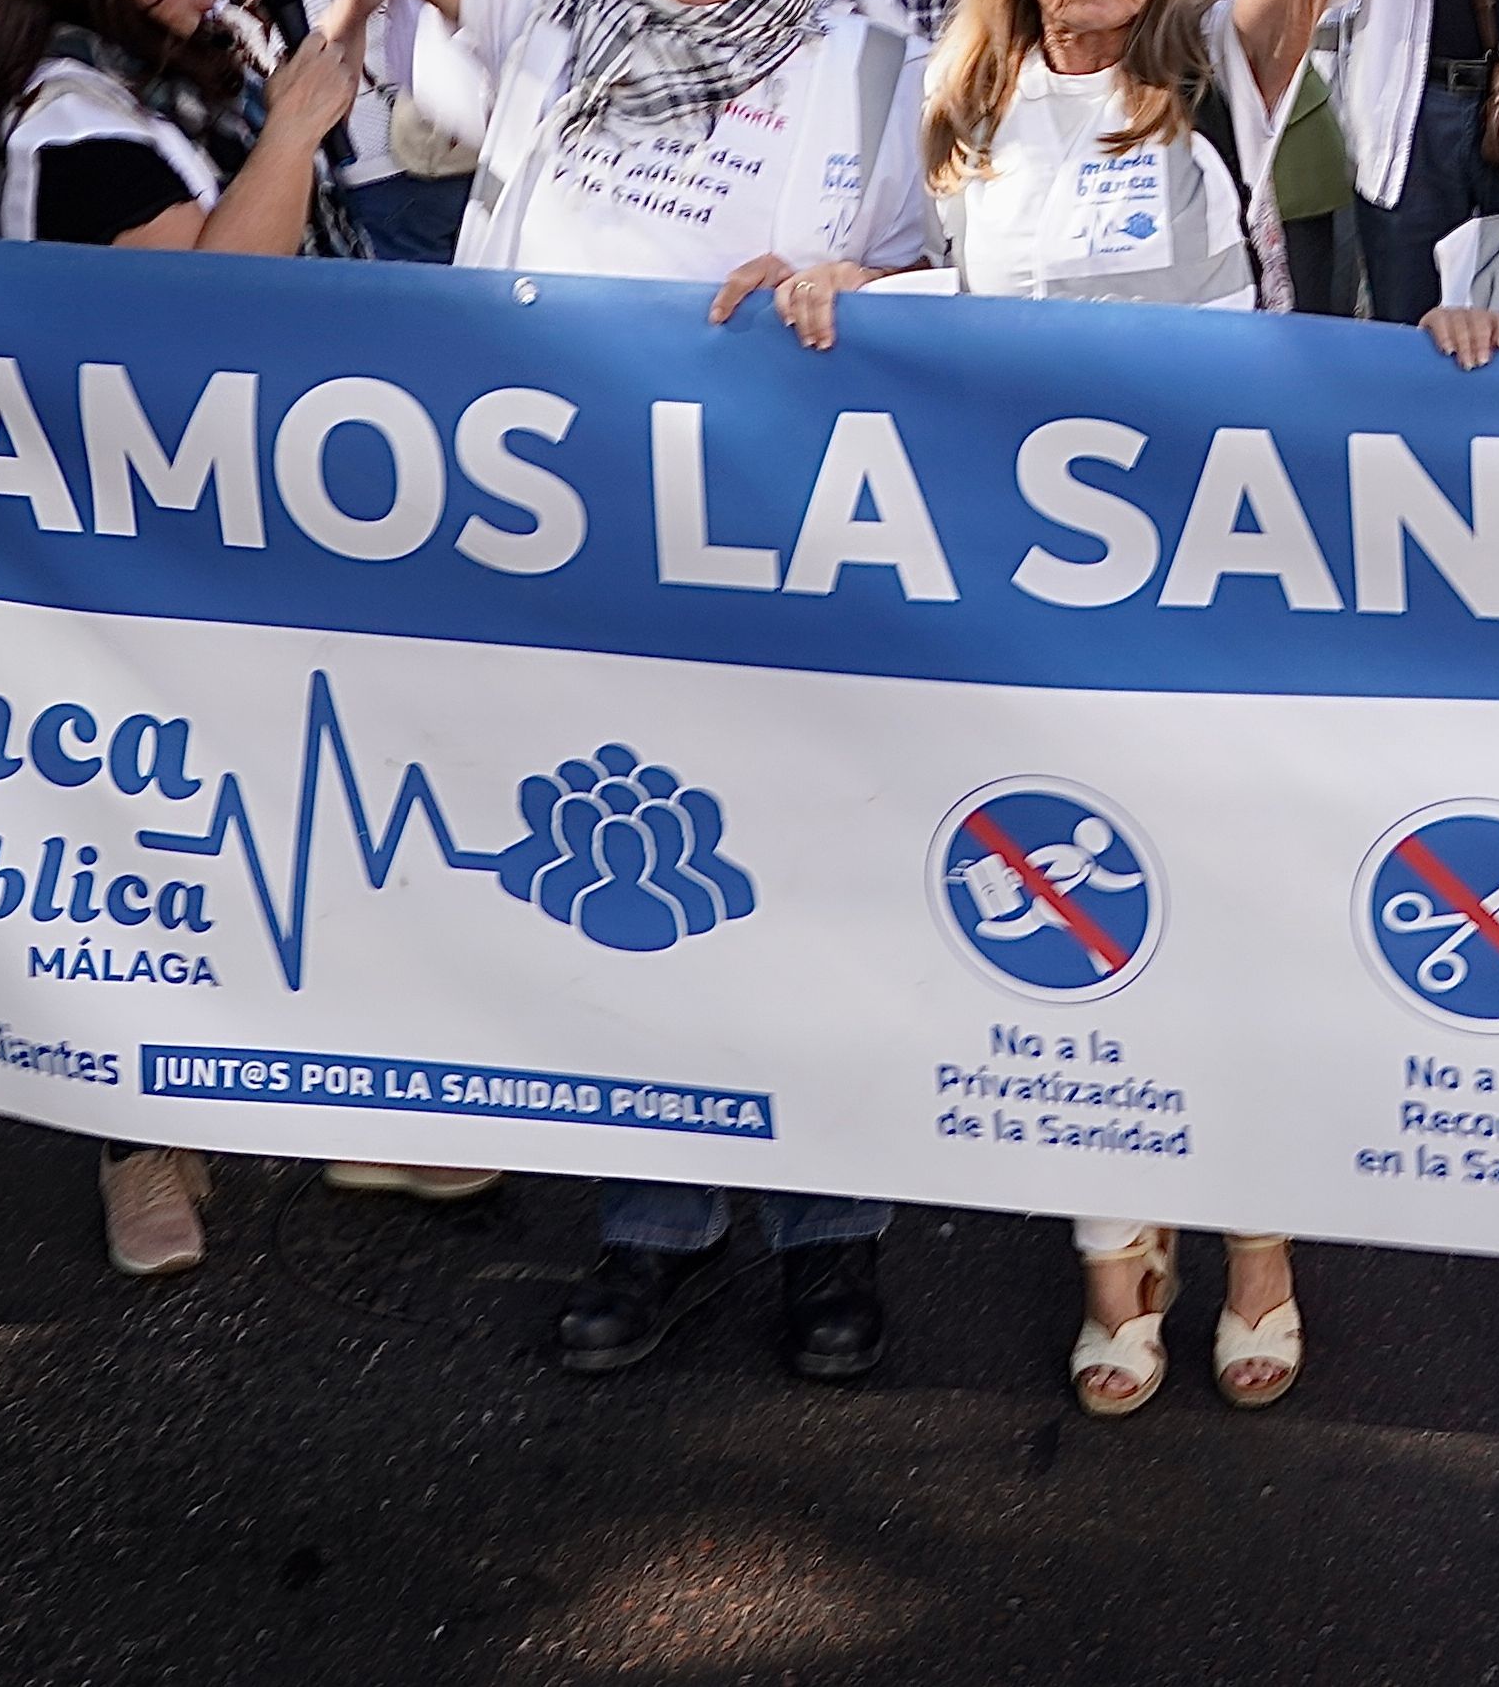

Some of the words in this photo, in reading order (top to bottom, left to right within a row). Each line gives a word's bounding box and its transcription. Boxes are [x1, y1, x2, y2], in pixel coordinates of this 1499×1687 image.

[653, 136, 765, 178] sandad
[1081, 152, 1157, 176] marea
[1077, 176, 1158, 198] blanca
[652, 401, 958, 603] LA
[30, 937, 219, 986] MÁLAGA
[991, 1024, 1043, 1058] No
[1057, 1038, 1077, 1060] a
[1089, 1030, 1122, 1064] la
[153, 1054, 291, 1093] JUNT@S
[302, 1063, 374, 1097] POR
[384, 1068, 433, 1101] LA
[442, 1075, 600, 1115] SANIDAD
[610, 1086, 765, 1131] PÚBLICA
[938, 1064, 1184, 1112] Privatización
[1406, 1056, 1459, 1089] No
[1475, 1069, 1495, 1092] a
[938, 1107, 982, 1137] de
[993, 1109, 1026, 1141] la
[1038, 1115, 1189, 1155] Sanidad
[1356, 1149, 1404, 1174] en
[1417, 1145, 1449, 1178] la
